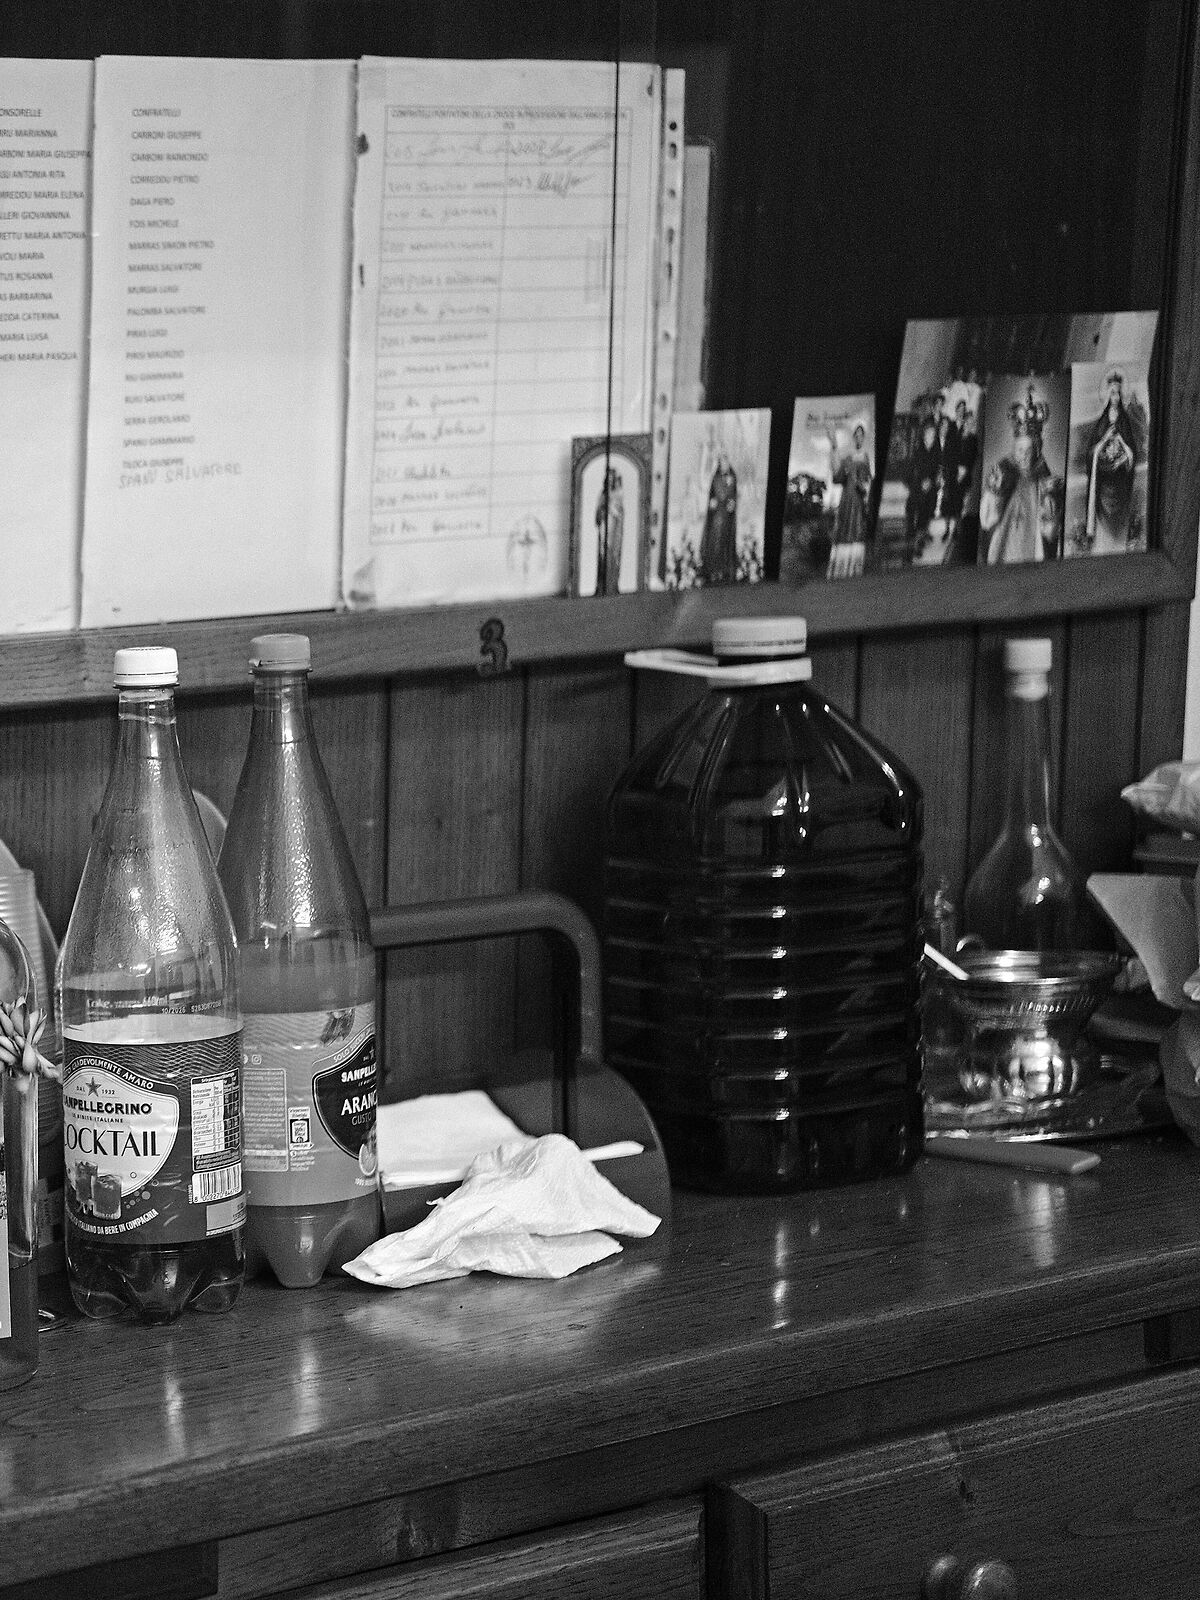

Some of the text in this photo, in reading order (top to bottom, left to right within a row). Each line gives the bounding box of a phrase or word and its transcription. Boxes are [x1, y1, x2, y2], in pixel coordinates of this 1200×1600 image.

[15, 129, 58, 138] MARIANNA
[27, 150, 52, 159] MARIA
[13, 170, 47, 179] ANTONIA
[49, 170, 65, 179] RITA
[34, 191, 58, 199] MARIA
[60, 190, 85, 199] ELENA
[24, 232, 50, 240] MARIA
[52, 231, 87, 240] ANTONIA
[18, 252, 45, 260] MARIA
[21, 312, 60, 321] CATERINA
[0, 333, 25, 342] MARIA
[17, 353, 44, 362] MARIA
[122, 1070, 154, 1090] AMARO
[63, 1094, 152, 1115] ANPELLEGRINO
[94, 1116, 124, 1124] ITALIANE
[351, 1111, 372, 1126] GUSTO
[64, 1123, 161, 1157] OCKTAIL
[104, 1224, 119, 1235] BERE
[125, 1207, 160, 1231] COMPAGNIA
